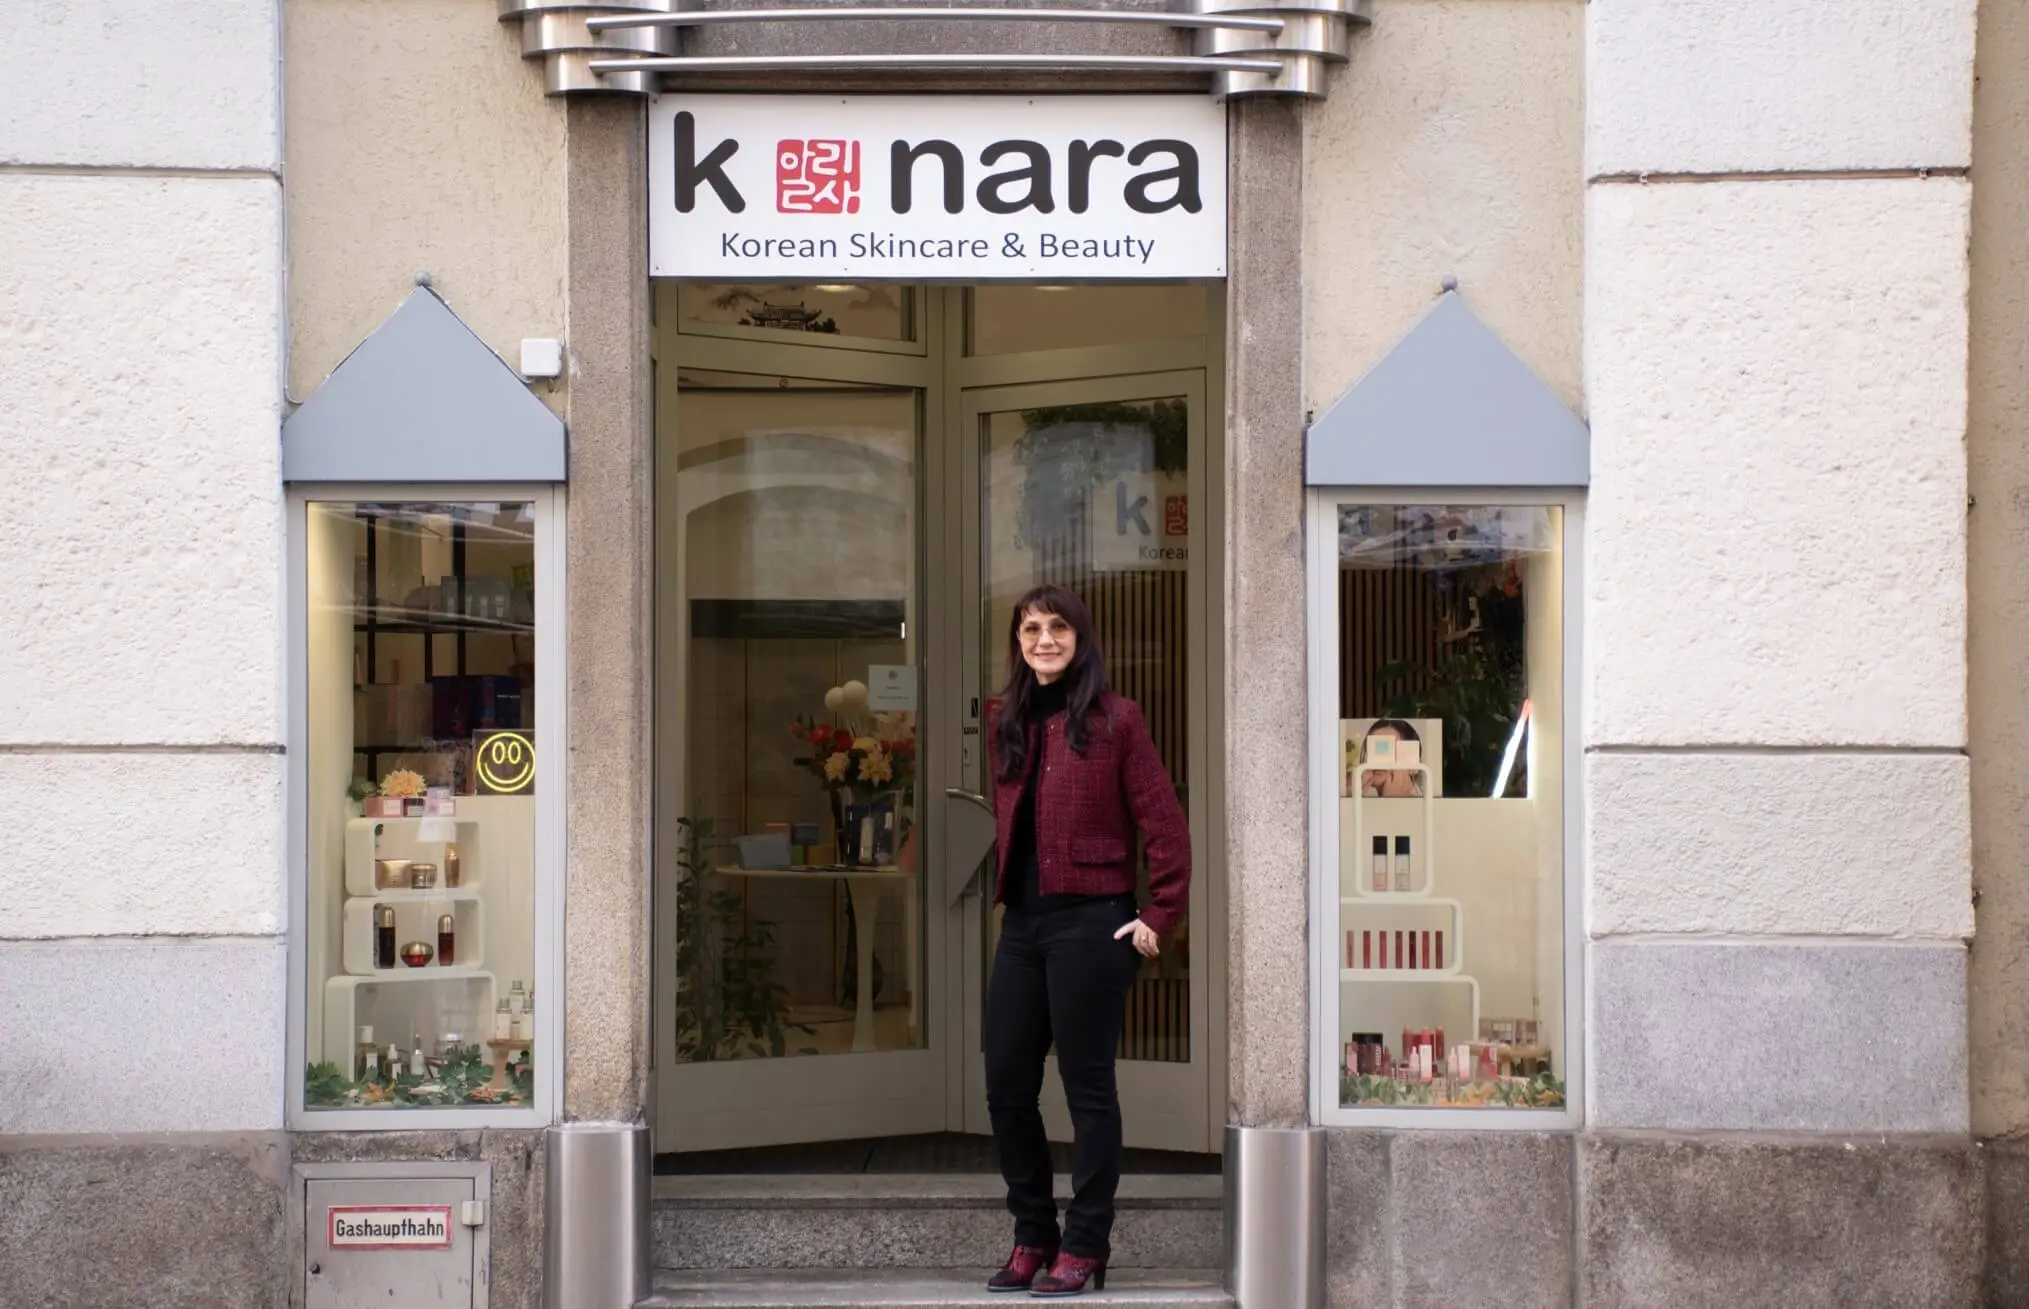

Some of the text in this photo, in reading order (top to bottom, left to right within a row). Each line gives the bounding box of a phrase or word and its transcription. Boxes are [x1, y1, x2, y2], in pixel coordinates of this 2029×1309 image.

[673, 110, 746, 214] k
[890, 138, 1203, 215] nara
[721, 232, 1156, 263] Korean Skincare & Beauty
[1116, 481, 1151, 536] k
[1139, 545, 1188, 560] Korea
[336, 1218, 444, 1238] Gashaupthahn
